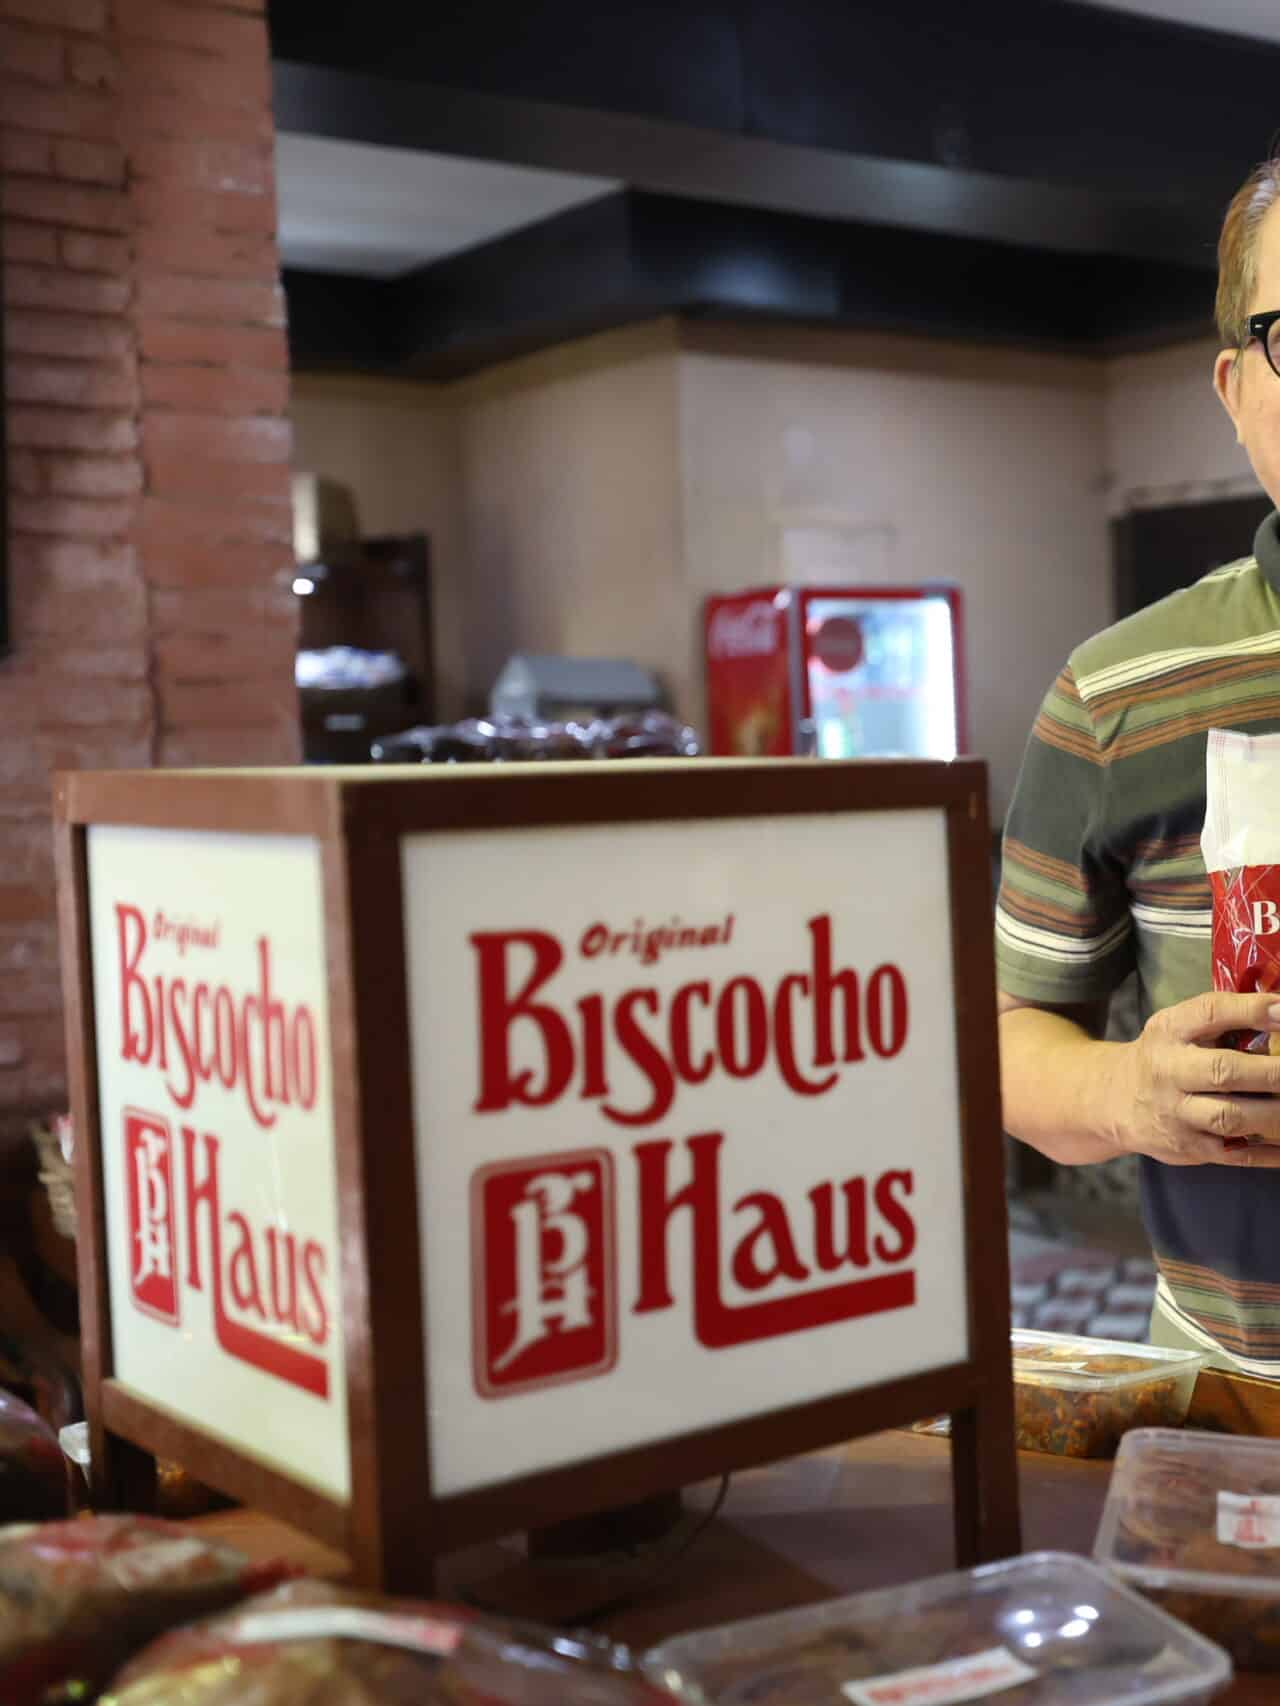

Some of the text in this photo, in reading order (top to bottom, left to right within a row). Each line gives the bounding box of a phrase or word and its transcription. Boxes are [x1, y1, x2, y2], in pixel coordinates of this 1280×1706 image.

[114, 901, 318, 1128] Biscocho
[470, 913, 909, 1127] Biscocho
[580, 912, 736, 967] Original
[181, 1124, 331, 1400] Haus
[632, 1132, 917, 1350] Haus
